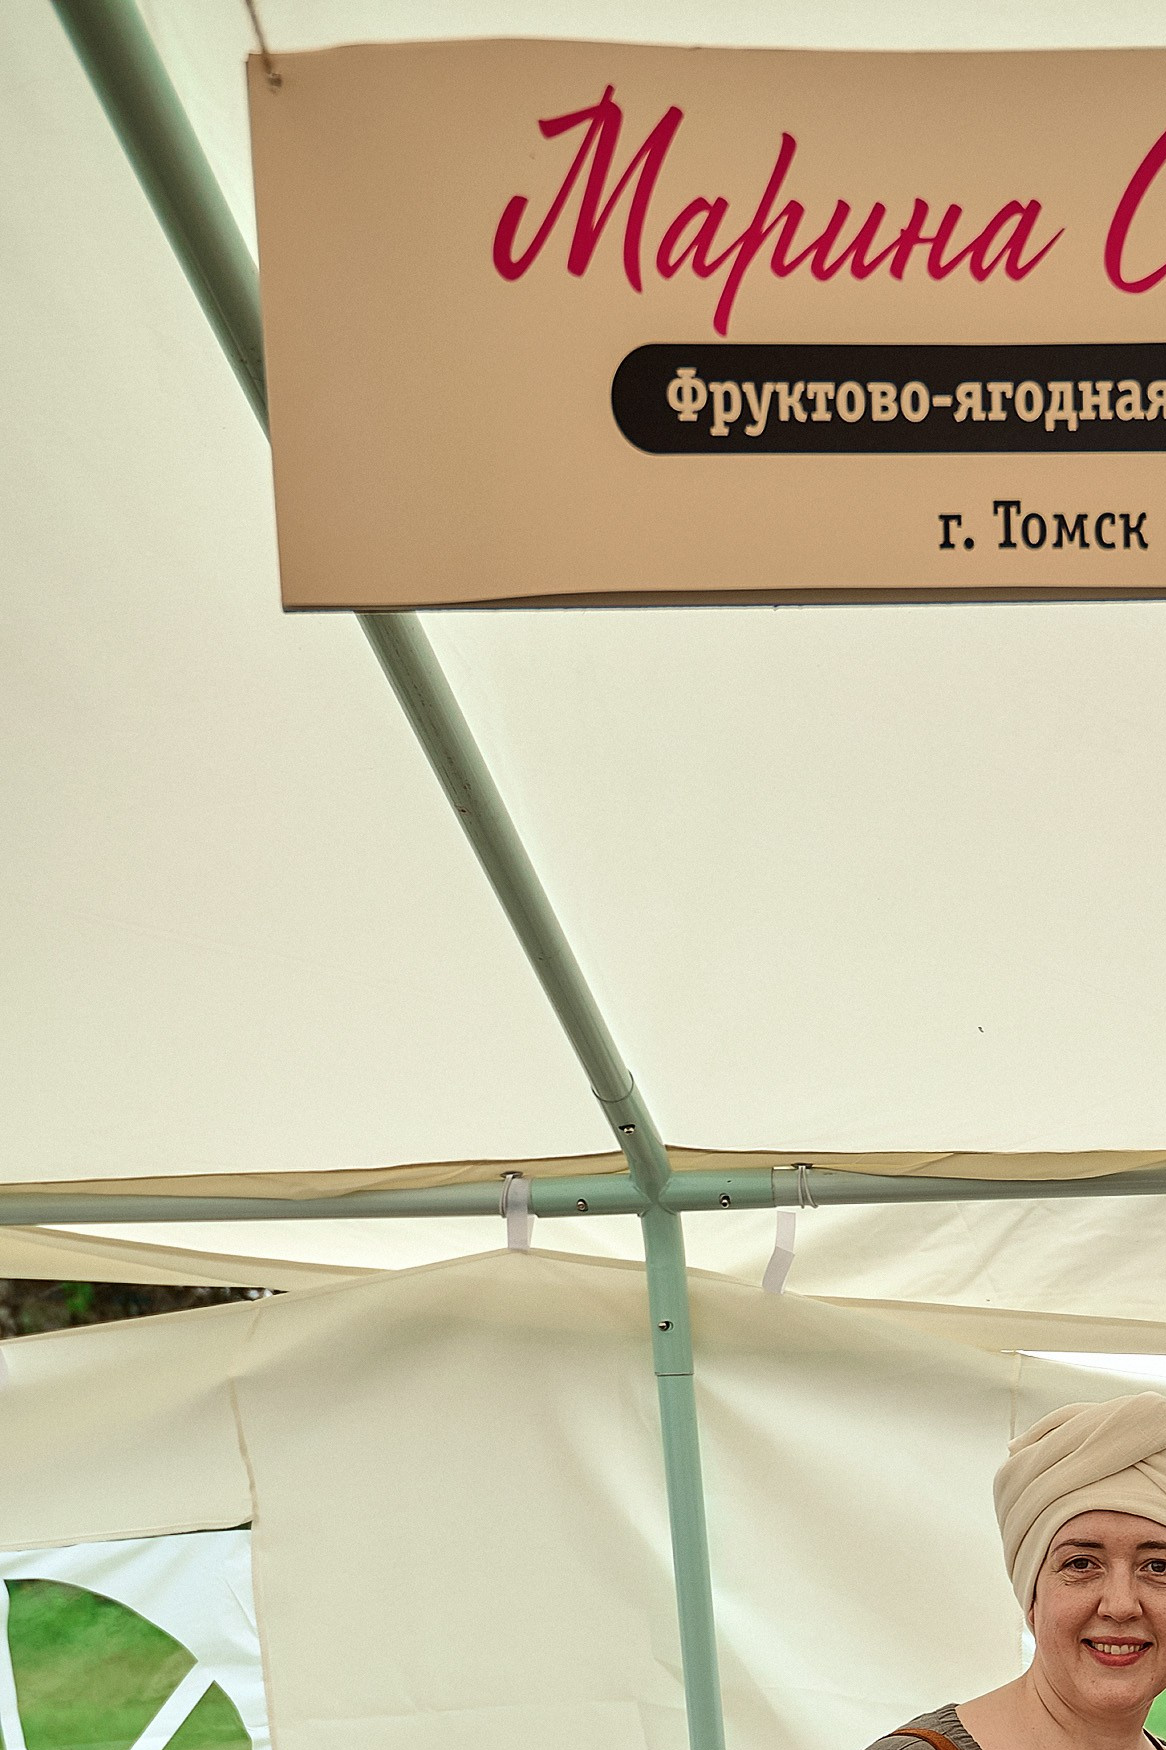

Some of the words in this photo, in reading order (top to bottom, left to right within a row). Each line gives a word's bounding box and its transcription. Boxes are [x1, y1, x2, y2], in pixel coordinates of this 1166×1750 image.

[492, 84, 1065, 337] Марина
[938, 512, 976, 550] г.
[993, 500, 1150, 550] Томск
